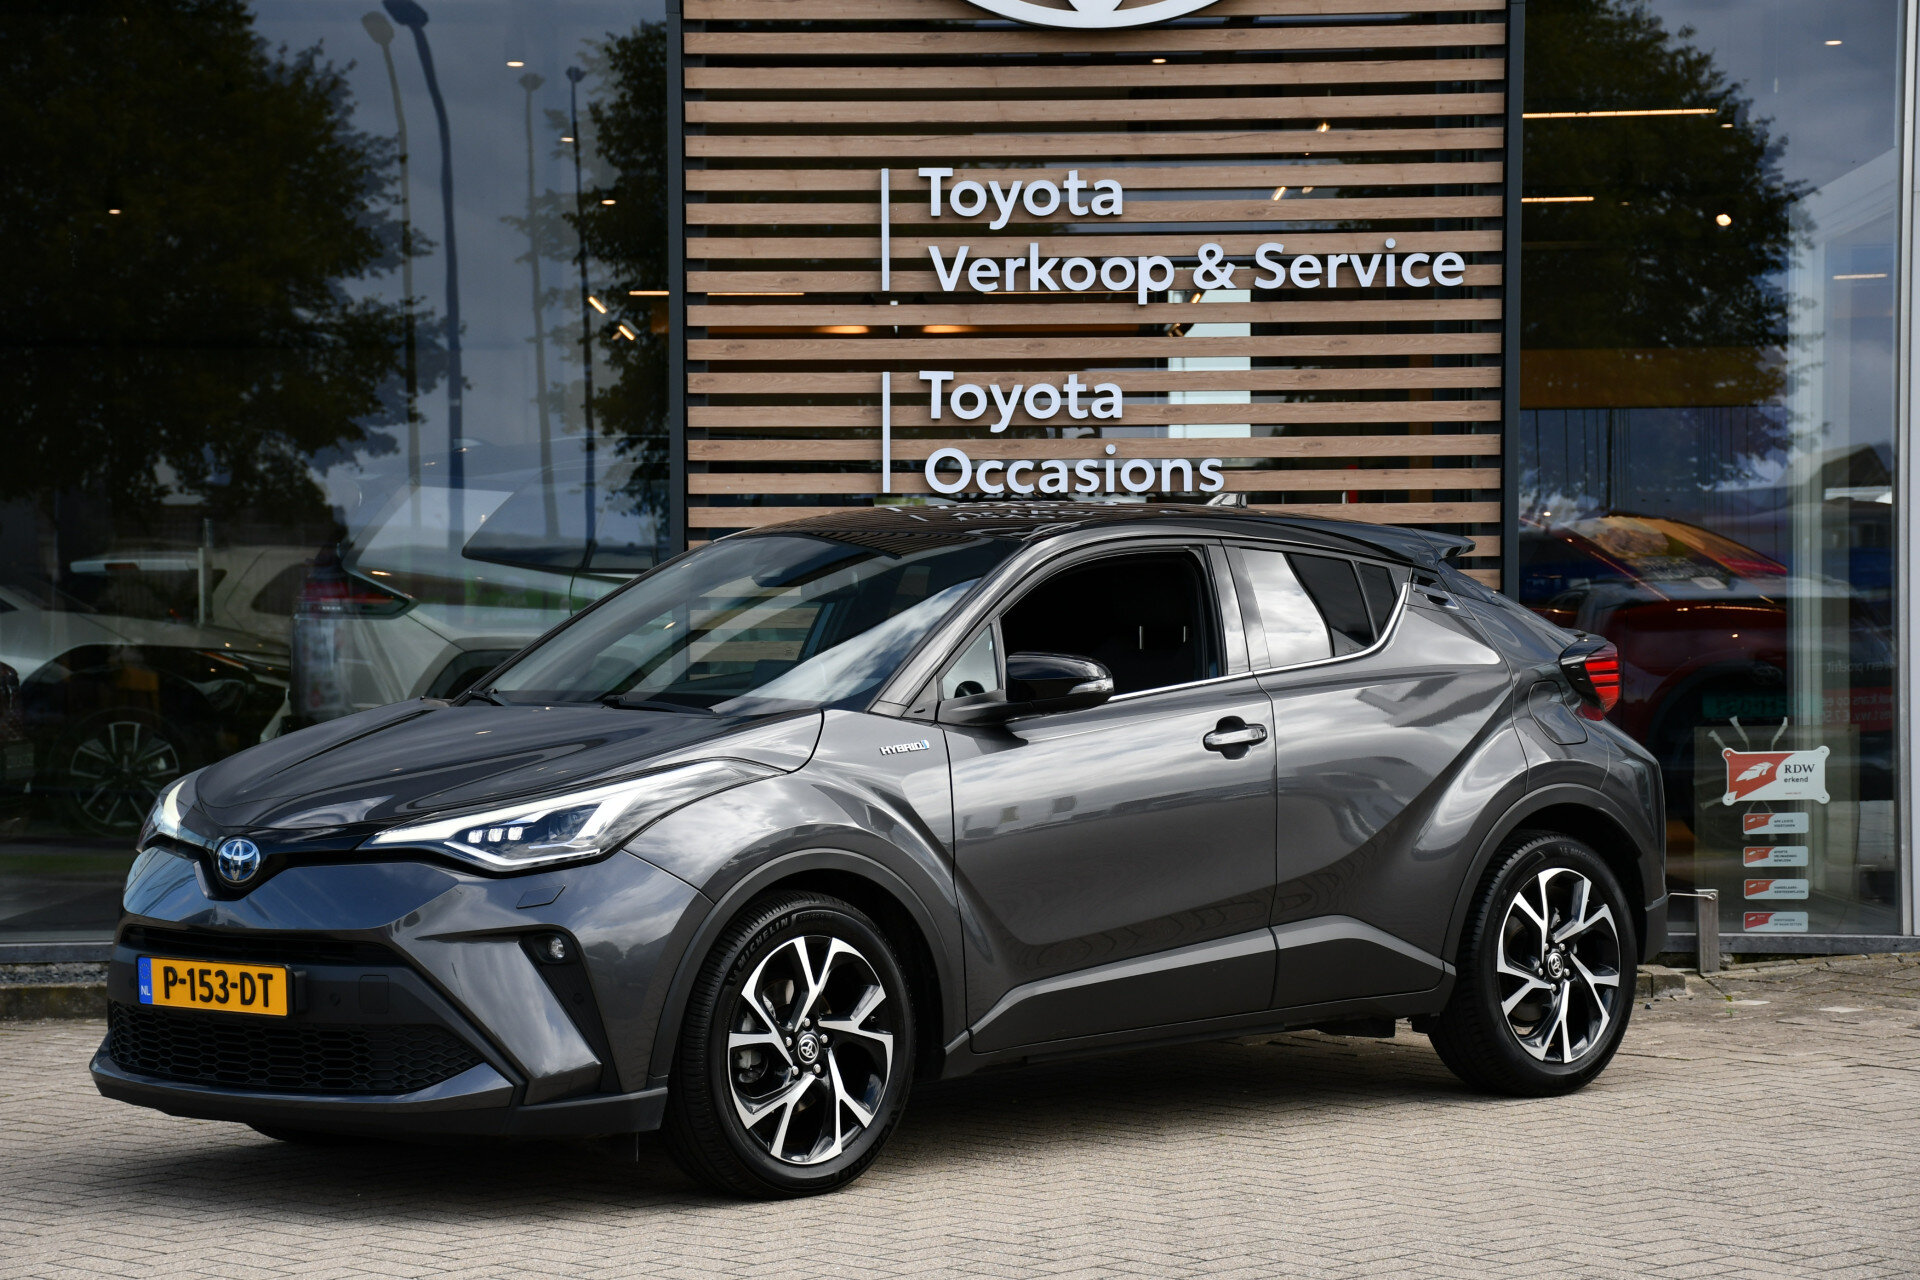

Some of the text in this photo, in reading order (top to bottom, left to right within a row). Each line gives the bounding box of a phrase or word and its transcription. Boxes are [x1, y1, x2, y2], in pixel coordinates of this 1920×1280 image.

[919, 168, 1122, 230] Toyota
[929, 239, 1465, 305] Verkoop & Service
[919, 371, 1122, 433] Toyota
[925, 445, 1224, 495] Occasions
[1783, 775, 1808, 784] erkend
[1784, 763, 1815, 774] RDW
[738, 918, 790, 967] MICHELIN
[140, 985, 151, 996] NL
[163, 966, 273, 1007] P-153-DT
